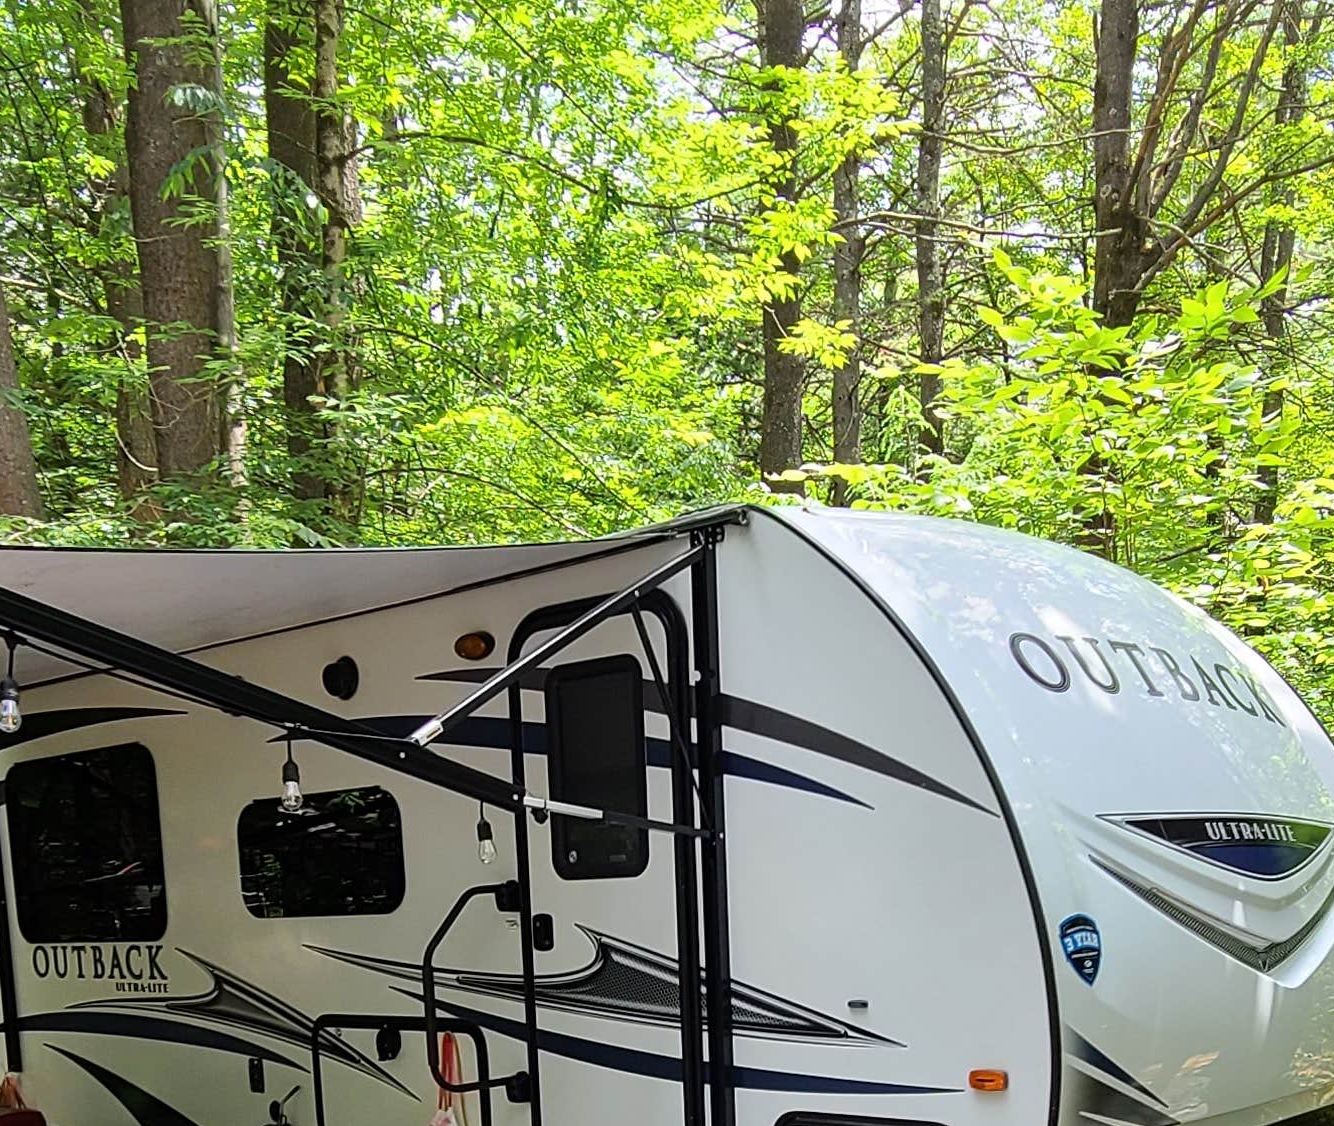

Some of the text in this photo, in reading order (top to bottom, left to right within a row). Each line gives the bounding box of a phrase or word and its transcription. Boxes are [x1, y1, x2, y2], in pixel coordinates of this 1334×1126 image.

[1009, 632, 1286, 727] OUTBACK
[1204, 821, 1297, 842] ULTRA-LITE
[32, 945, 169, 981] OUTBACK
[115, 982, 169, 994] ULTRA-LITE
